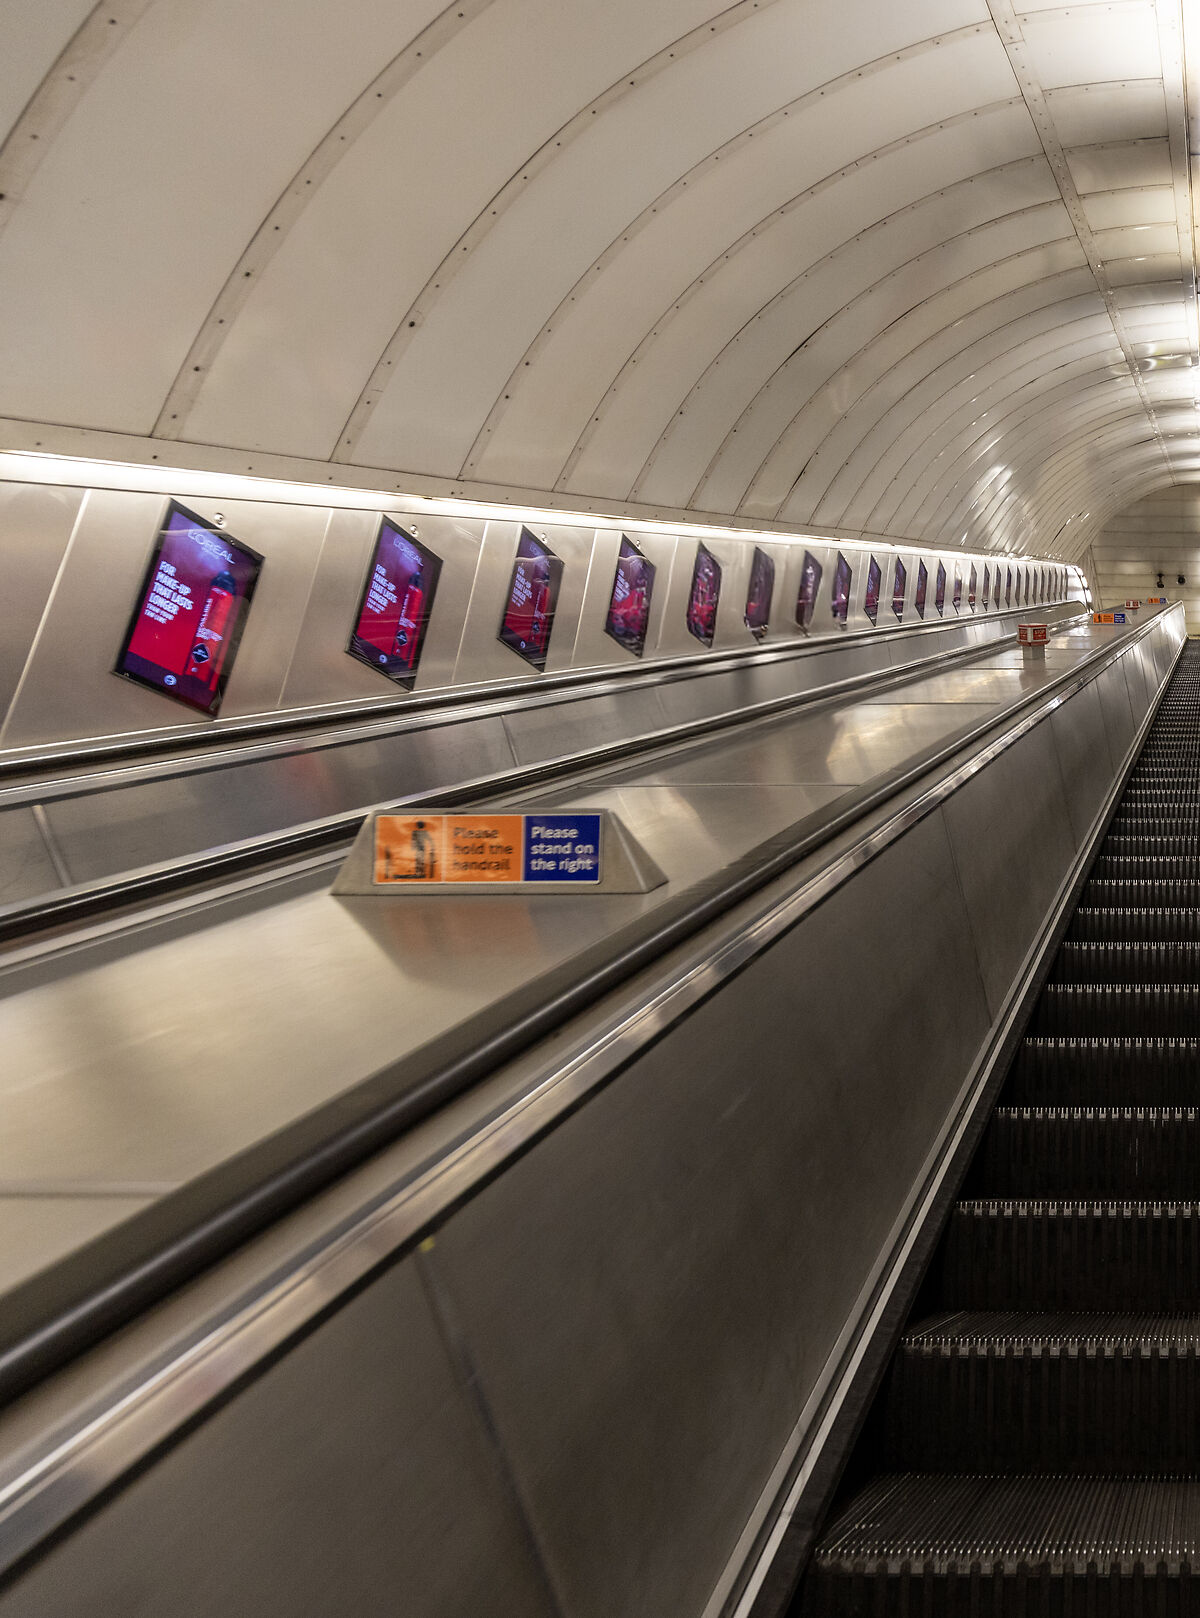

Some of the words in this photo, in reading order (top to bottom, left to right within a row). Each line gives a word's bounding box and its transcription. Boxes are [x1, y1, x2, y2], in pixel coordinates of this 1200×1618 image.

[159, 560, 176, 576] FOR
[156, 571, 191, 595] MAKE-UP
[149, 592, 179, 615] LONGER
[153, 582, 173, 599] THAT
[170, 591, 194, 611] LASTS
[453, 827, 499, 839] Please
[531, 826, 579, 839] Please
[454, 843, 485, 855] hold
[488, 844, 513, 855] the
[530, 842, 573, 855] stand
[574, 844, 594, 855] on
[453, 859, 511, 871] handrail
[530, 857, 557, 870] the
[558, 858, 594, 873] right
